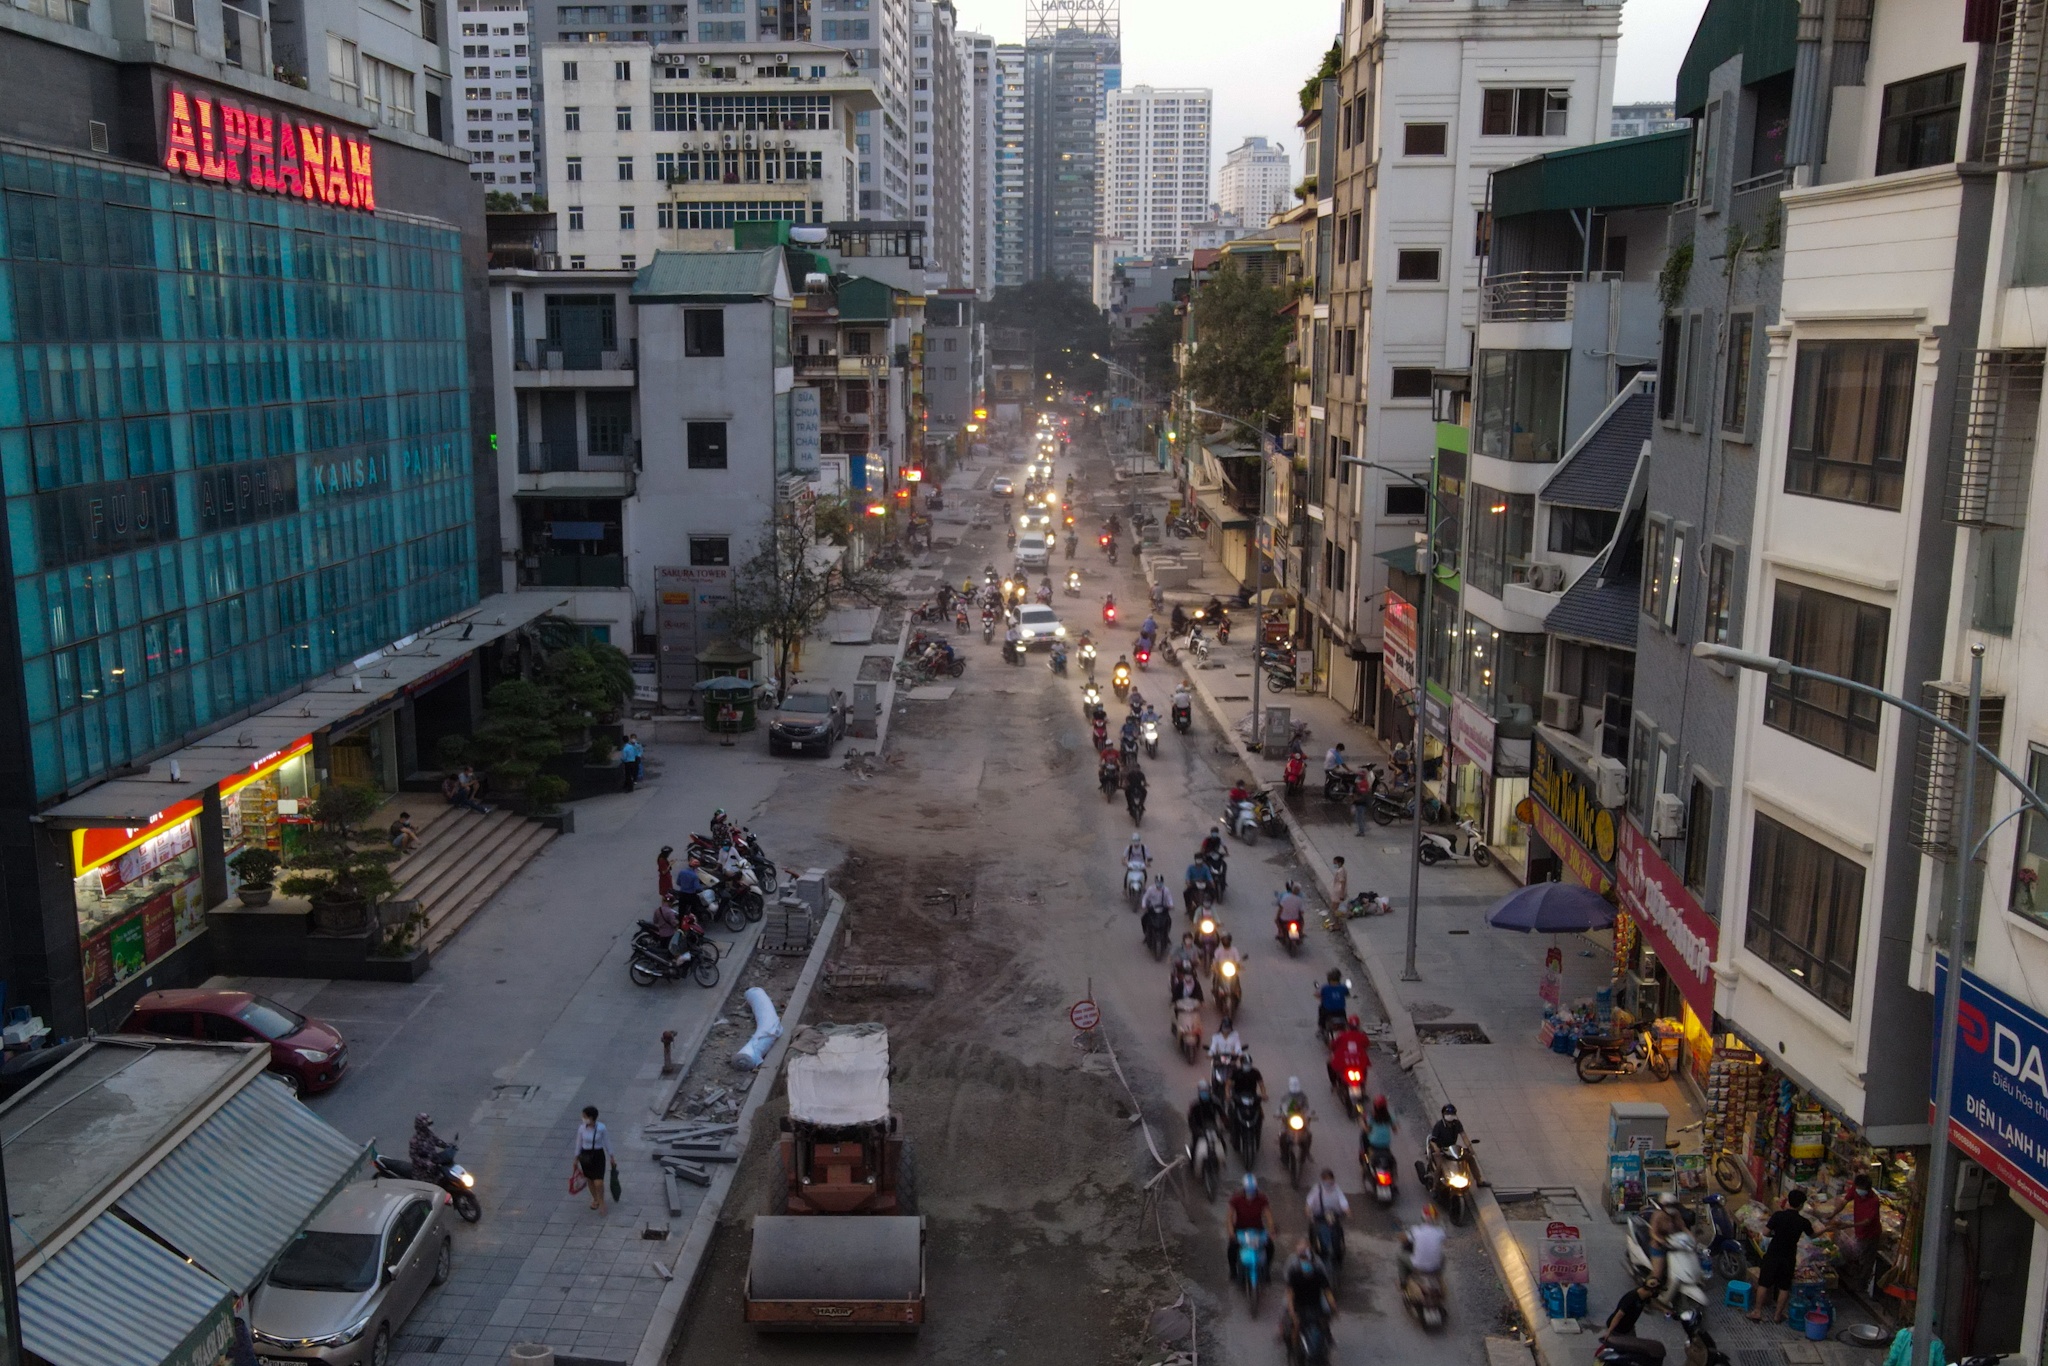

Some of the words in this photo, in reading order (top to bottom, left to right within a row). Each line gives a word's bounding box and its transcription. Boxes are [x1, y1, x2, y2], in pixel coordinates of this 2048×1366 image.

[1041, 0, 1095, 10] HANDICO
[1097, 0, 1105, 10] 6
[166, 82, 375, 211] ALPHANAM
[314, 454, 387, 495] KANSAI
[403, 443, 450, 475] PAINT
[89, 487, 169, 539] FUJI
[202, 470, 284, 517] ALPHA
[662, 569, 694, 577] SAKURA
[697, 570, 726, 578] TOWER
[1993, 1071, 2014, 1096] Điều
[2016, 1085, 2033, 1109] hòa
[1966, 1094, 1995, 1130] ĐIỆN
[1999, 1117, 2033, 1158] LẠNH
[817, 1307, 849, 1315] HAMM
